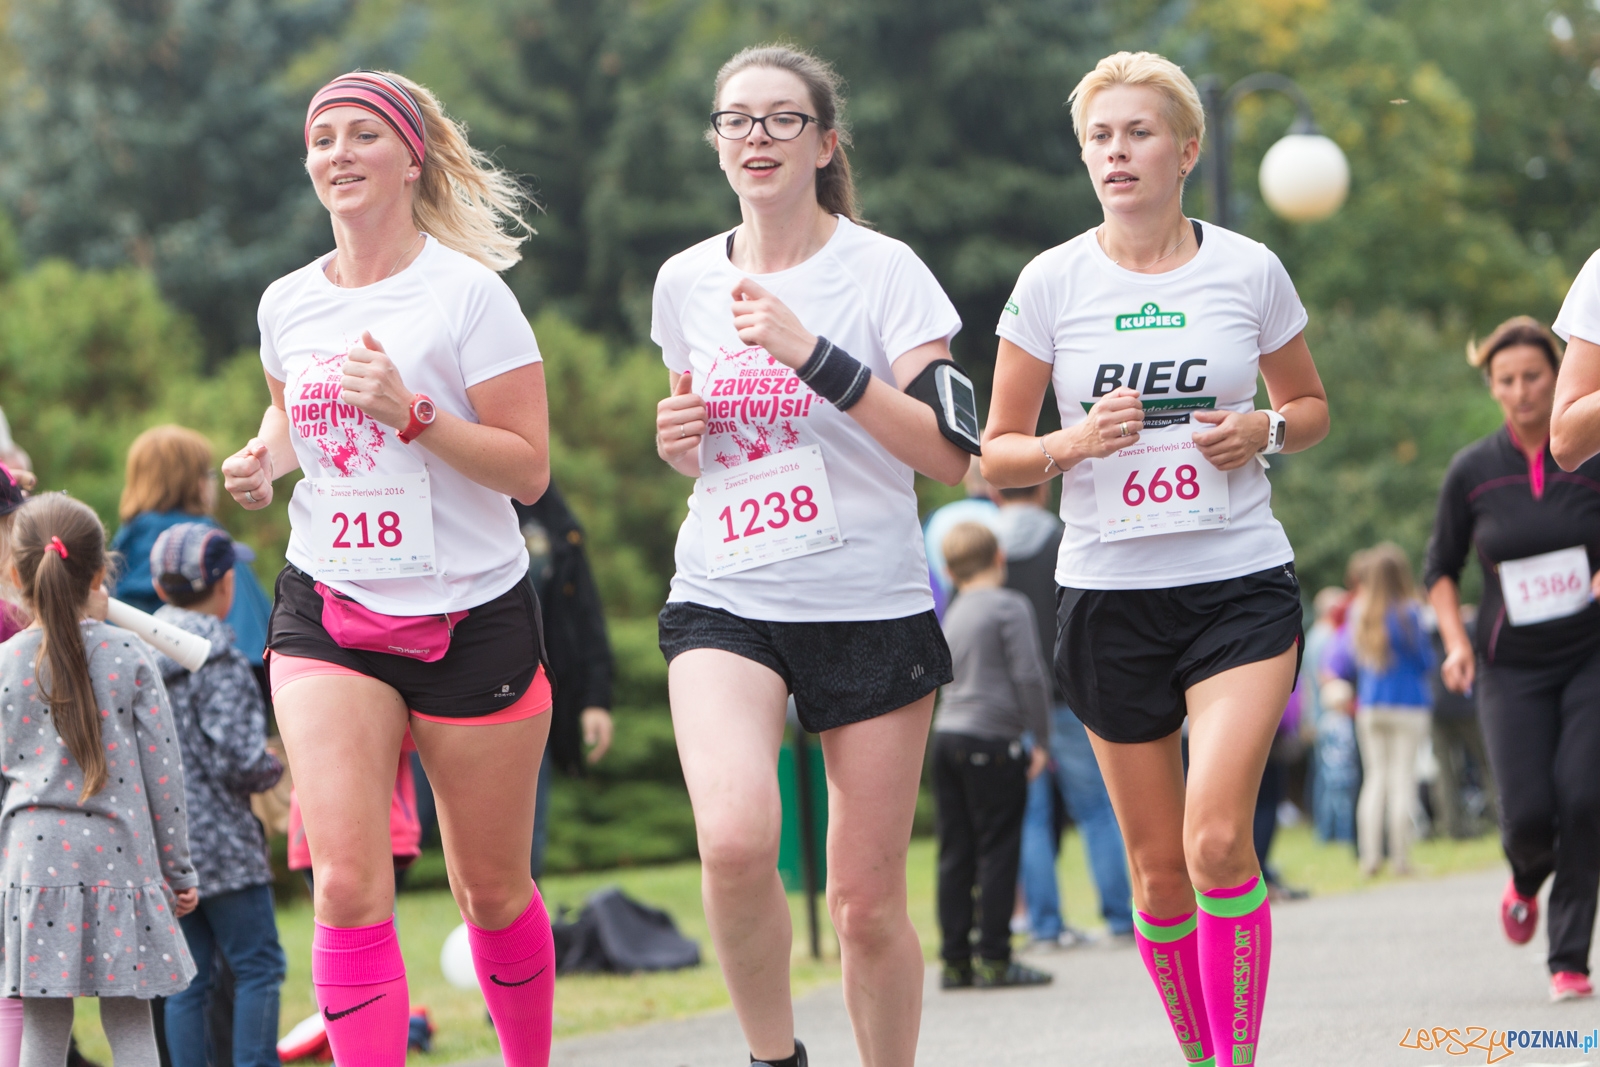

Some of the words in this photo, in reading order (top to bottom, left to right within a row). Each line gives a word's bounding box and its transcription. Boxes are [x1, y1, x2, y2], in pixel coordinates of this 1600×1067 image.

[1120, 315, 1182, 329] KUPIEC
[739, 369, 759, 377] BIEG
[759, 368, 791, 377] KOBIET
[1092, 358, 1208, 398] BIEG
[300, 382, 344, 401] zaw
[711, 377, 800, 397] zawsze
[291, 400, 374, 428] pier(w)
[298, 421, 328, 438] 2016
[708, 420, 738, 436] 2016
[1118, 448, 1146, 458] Zawsze
[1146, 443, 1180, 454] Pier(w)si
[1181, 440, 1197, 450] 201
[725, 477, 749, 490] Zawsze
[749, 469, 779, 483] Pier(w)si
[780, 463, 800, 475] 2016
[1122, 464, 1201, 507] 668
[330, 488, 352, 497] Zawsze
[352, 487, 383, 498] Pier(w)si
[384, 487, 405, 496] 2016
[718, 485, 819, 544] 1238
[331, 511, 403, 549] 218
[1518, 568, 1583, 605] 1386
